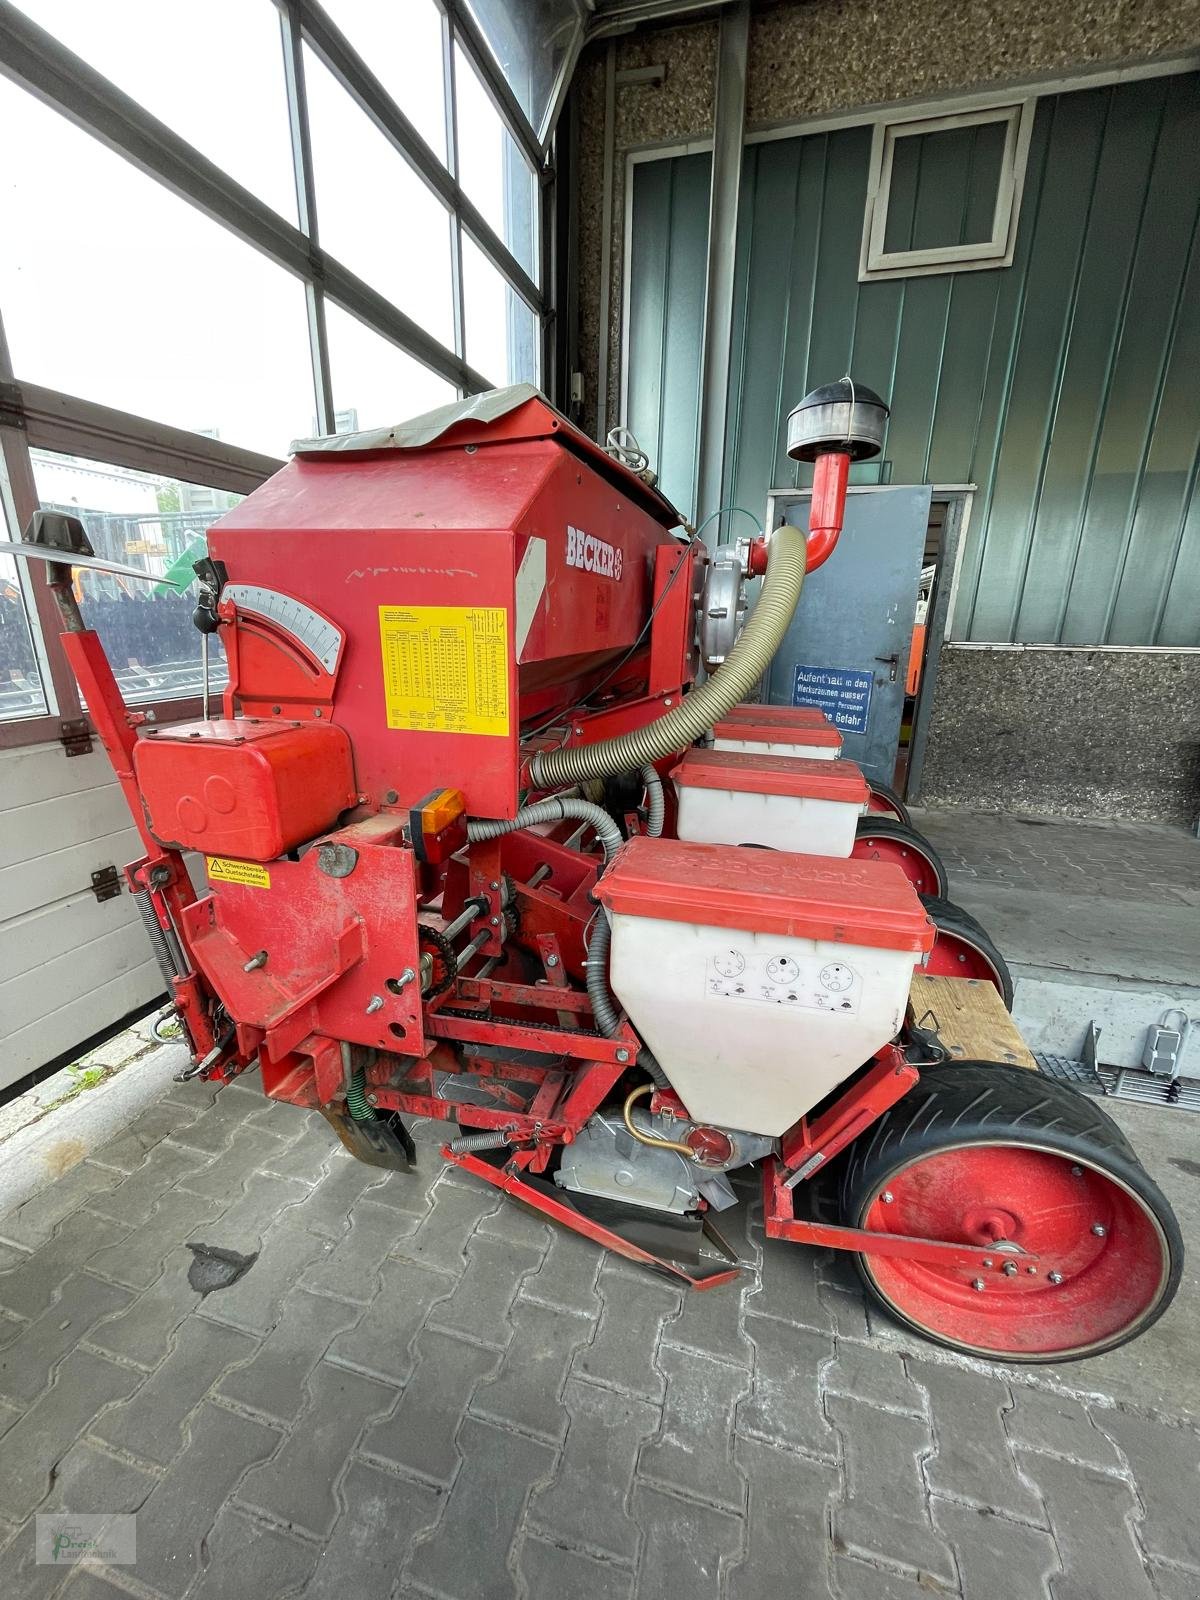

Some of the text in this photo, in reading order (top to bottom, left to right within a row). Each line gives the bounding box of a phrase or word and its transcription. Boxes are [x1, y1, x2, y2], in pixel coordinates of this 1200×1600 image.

[566, 525, 614, 578] BECKER
[845, 679, 852, 687] in
[854, 678, 868, 689] den
[840, 691, 865, 700] ausser
[837, 701, 864, 712] Personen
[835, 712, 862, 726] Gefahr
